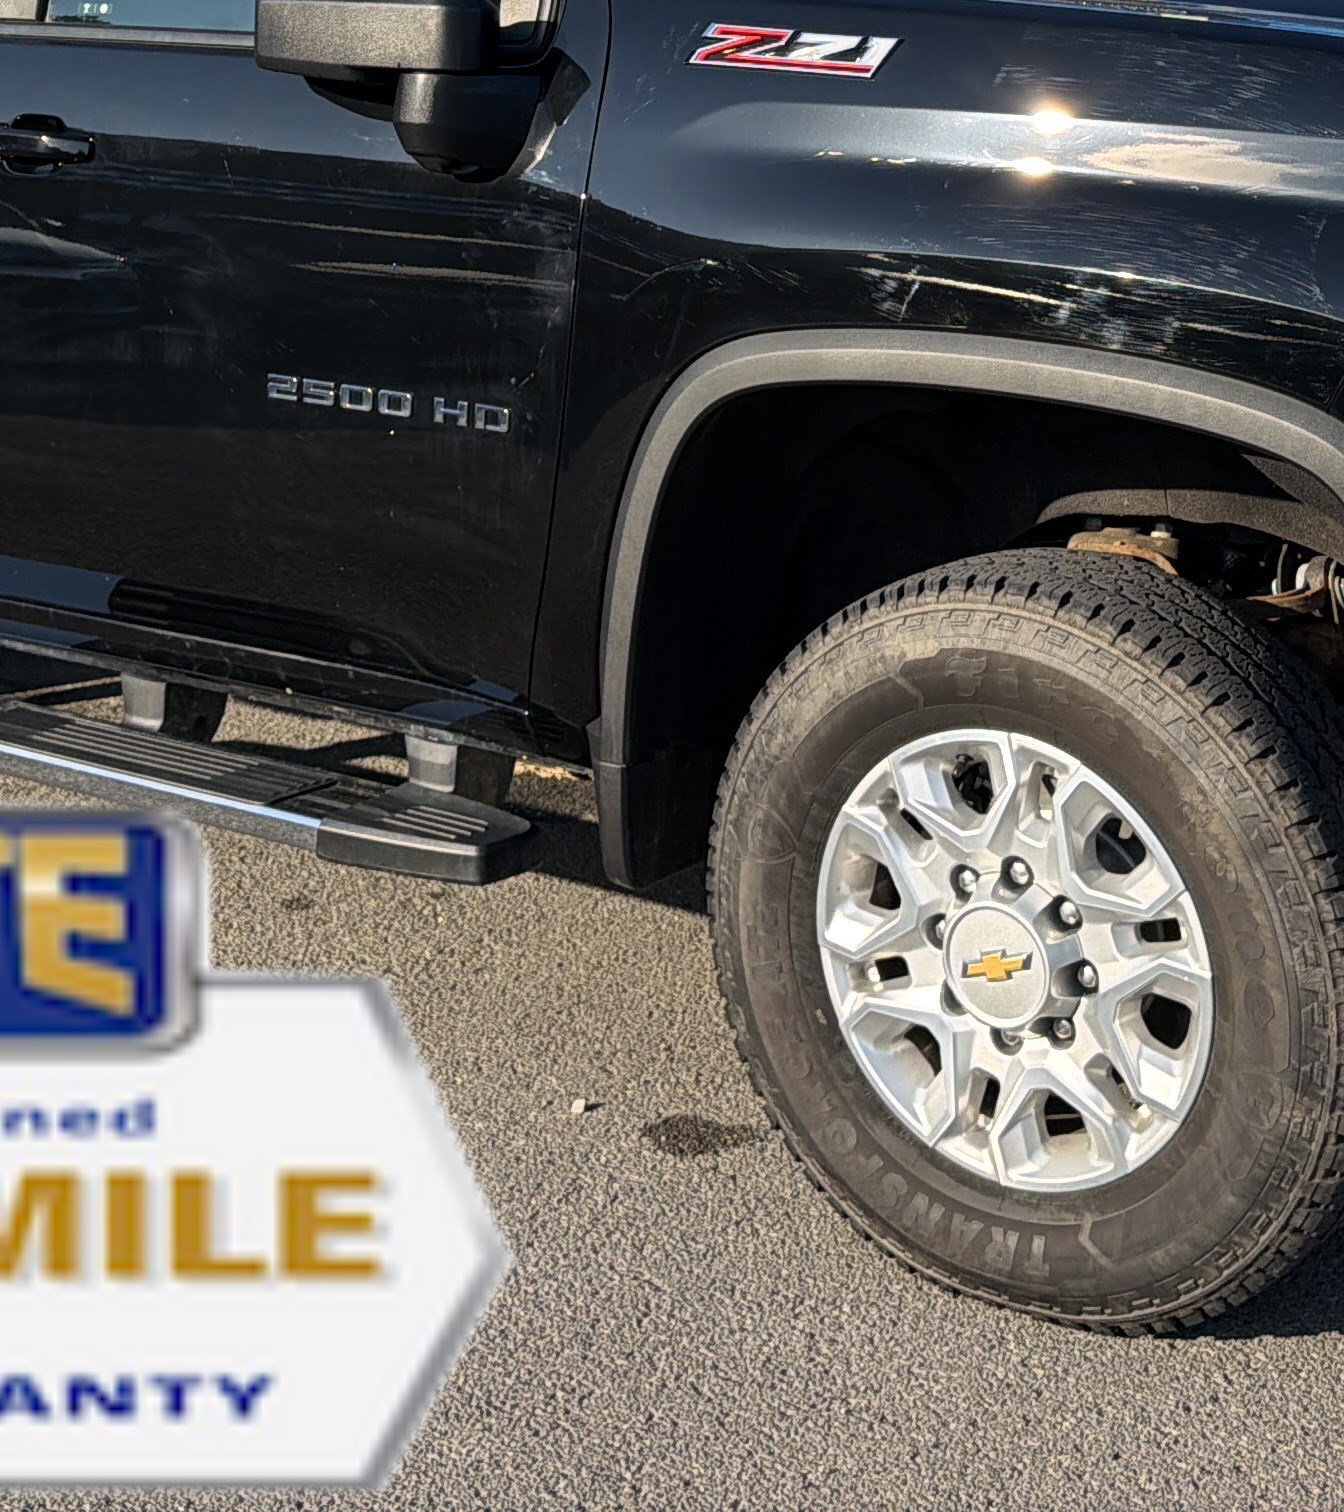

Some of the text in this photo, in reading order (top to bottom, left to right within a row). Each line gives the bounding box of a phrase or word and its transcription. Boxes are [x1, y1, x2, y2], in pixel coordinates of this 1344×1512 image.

[684, 22, 906, 79] Z71
[267, 372, 511, 433] 2500 HD
